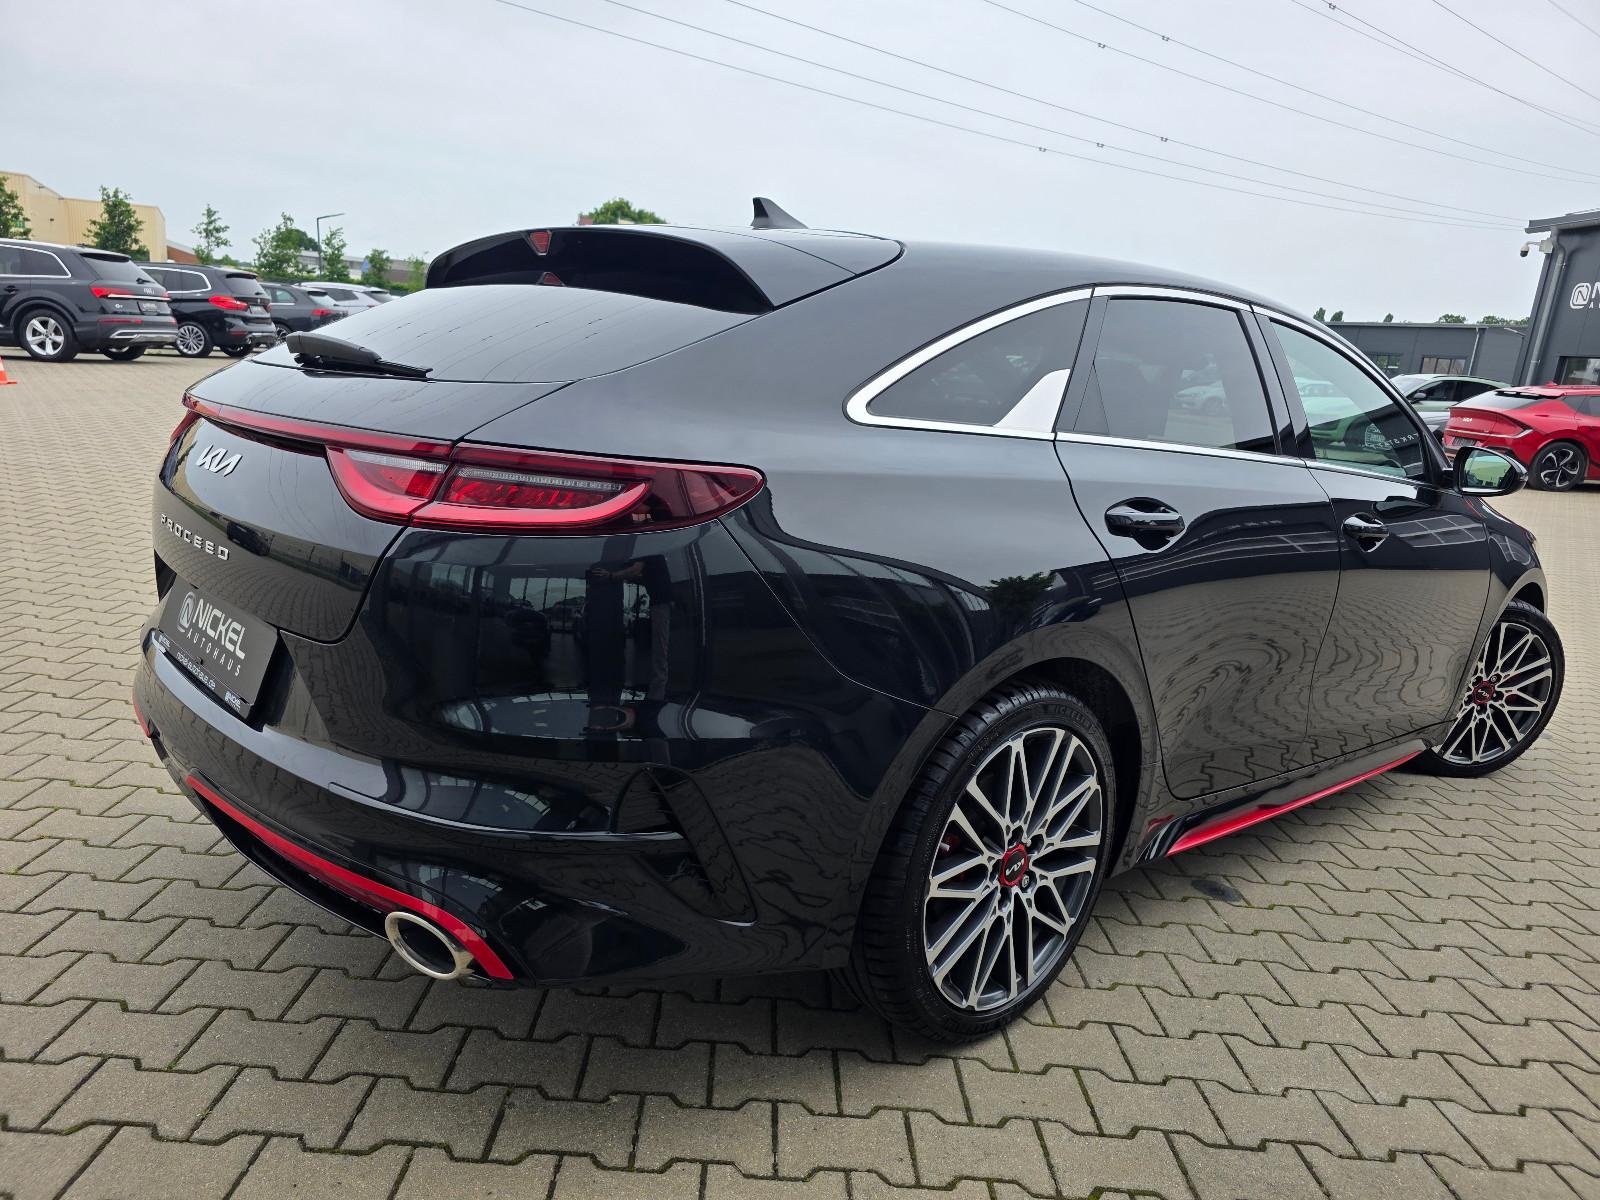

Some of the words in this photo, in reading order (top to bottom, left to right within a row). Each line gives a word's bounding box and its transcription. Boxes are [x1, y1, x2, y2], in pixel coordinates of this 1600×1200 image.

[195, 444, 243, 477] KIA
[160, 513, 229, 561] PROCEED
[186, 628, 241, 677] AUTOHAUS
[192, 598, 246, 660] NICKEL
